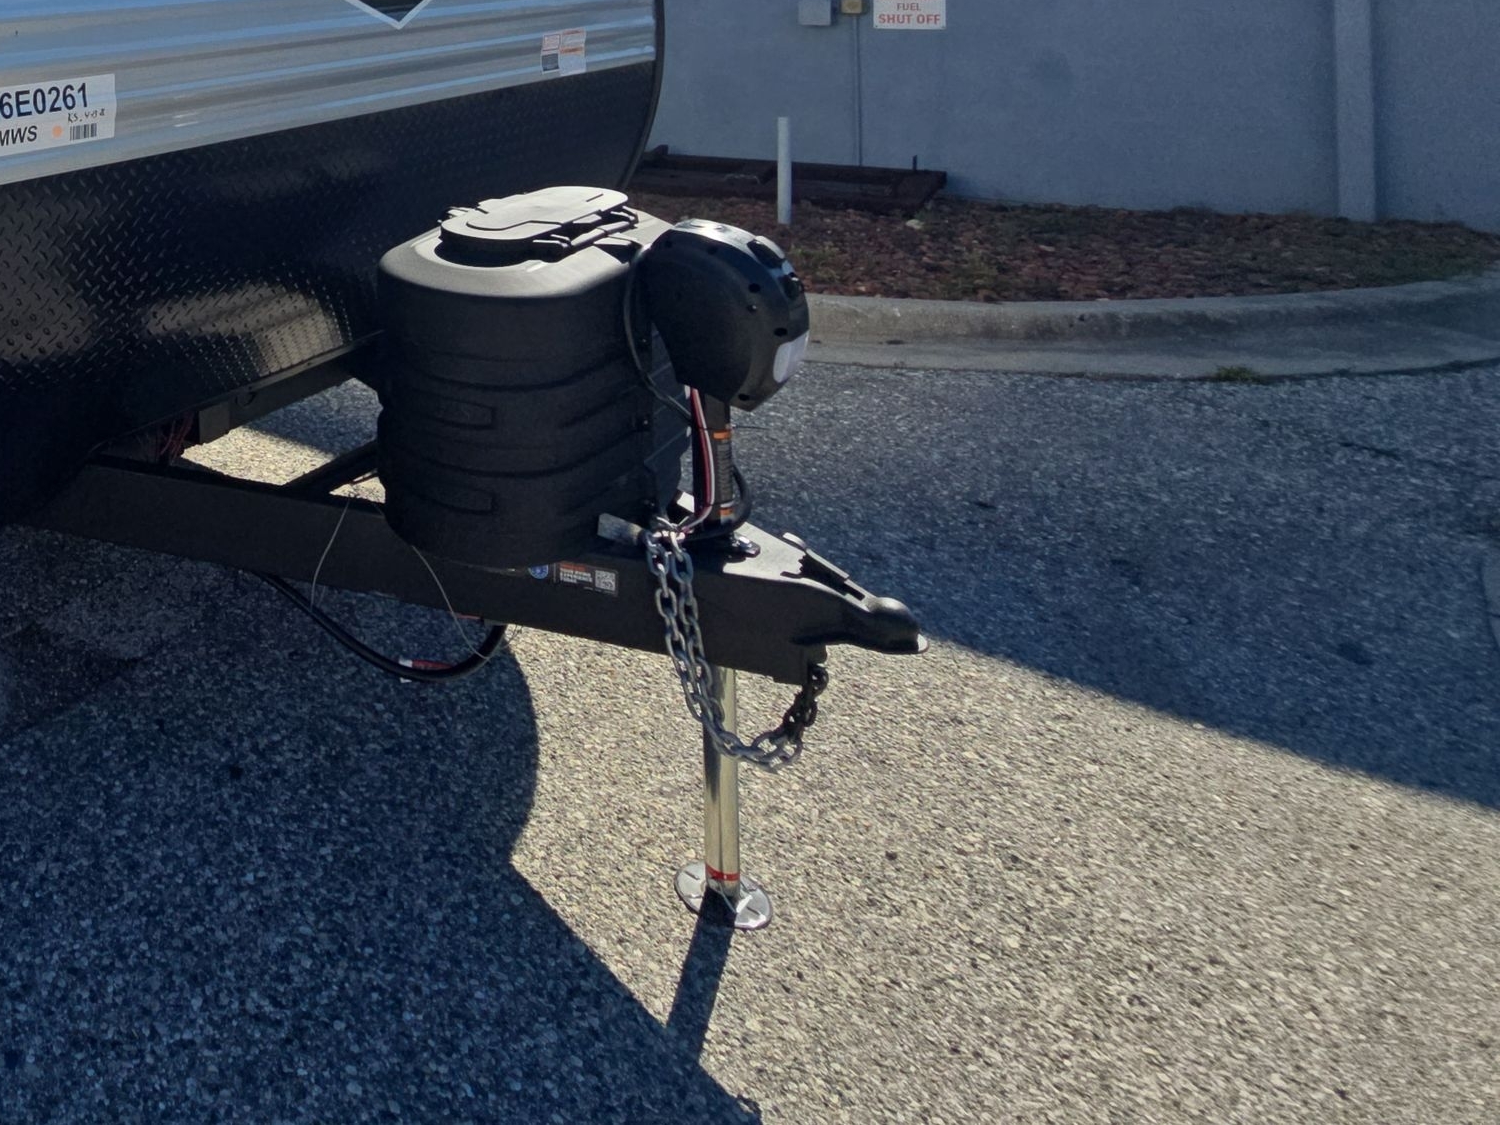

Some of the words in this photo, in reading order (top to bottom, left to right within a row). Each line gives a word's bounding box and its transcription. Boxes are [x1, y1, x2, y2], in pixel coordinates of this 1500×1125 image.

[896, 3, 922, 11] FUEL
[878, 14, 912, 24] SHUT
[916, 14, 941, 24] OFF
